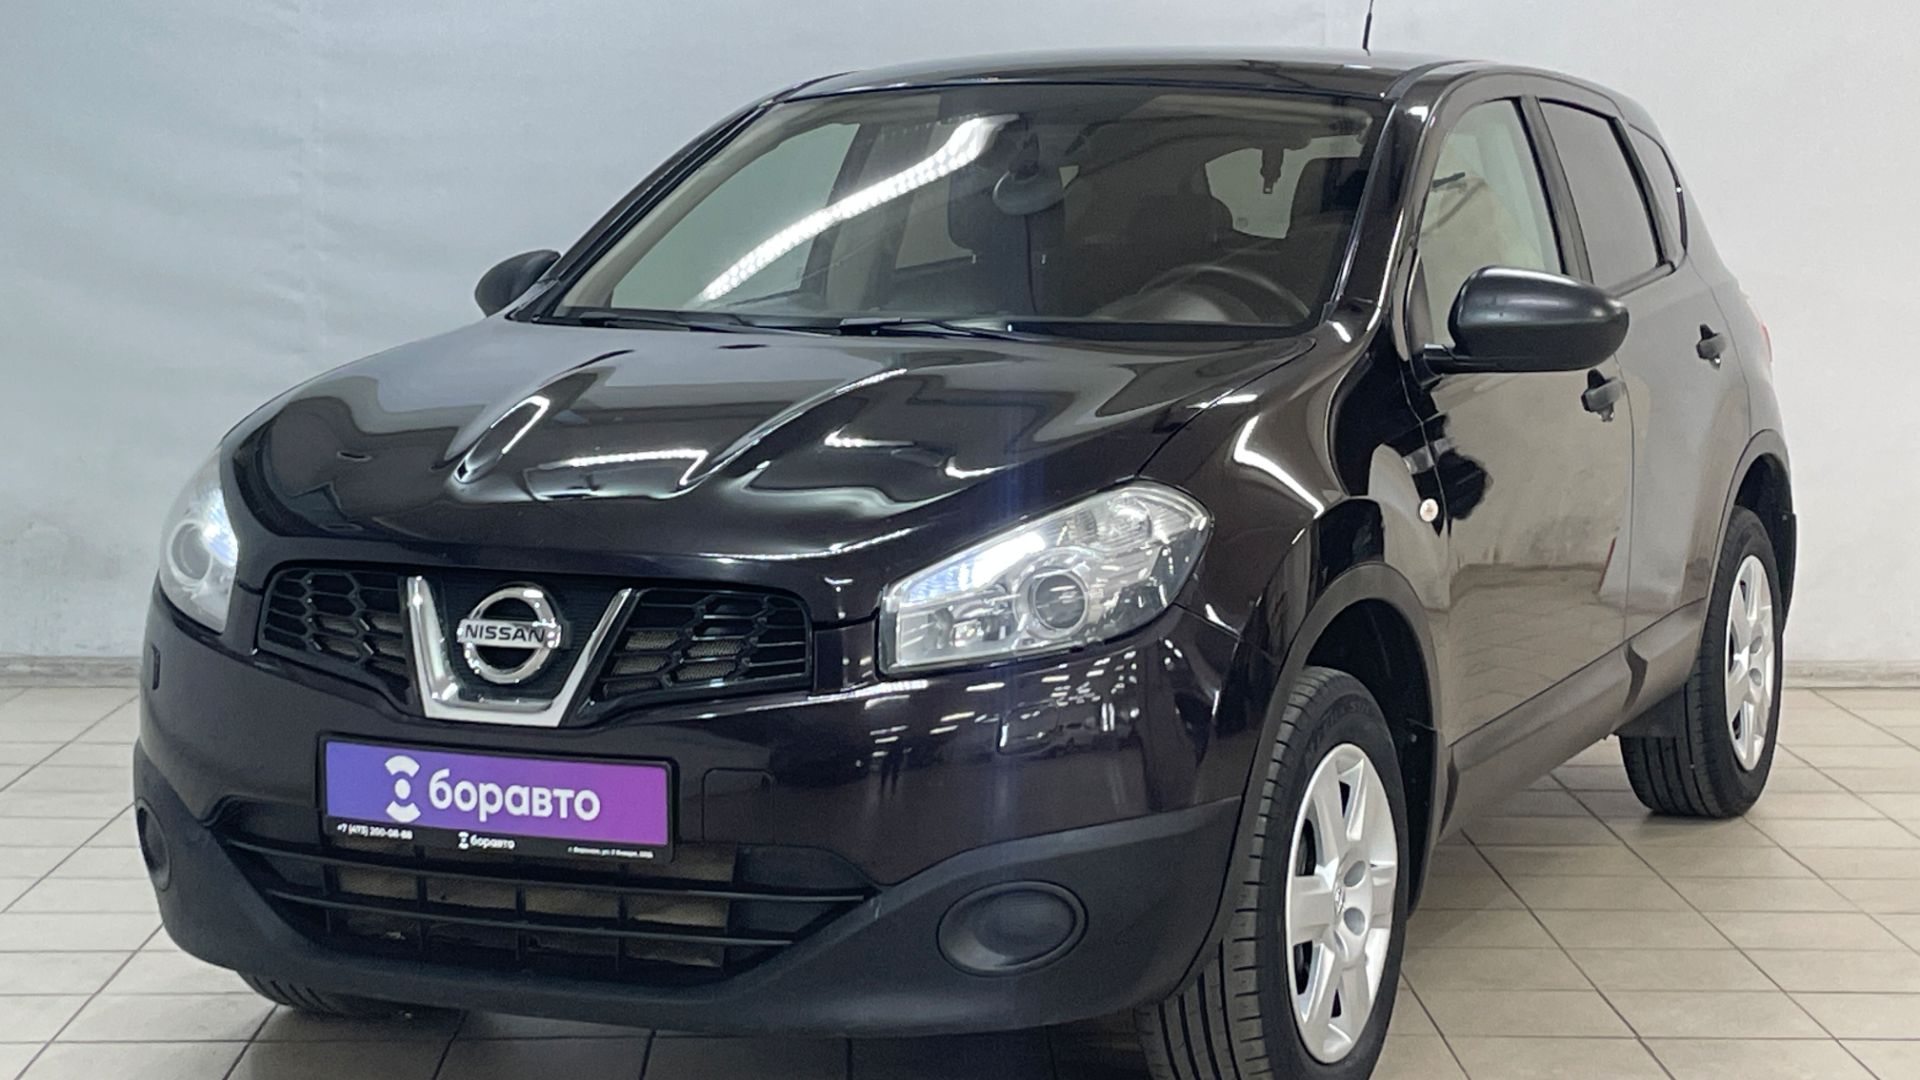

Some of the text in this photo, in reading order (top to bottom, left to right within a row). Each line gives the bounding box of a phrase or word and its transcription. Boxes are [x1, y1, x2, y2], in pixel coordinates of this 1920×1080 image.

[465, 624, 545, 643] NISSAN
[428, 768, 601, 822] боравто
[470, 834, 515, 849] боравто
